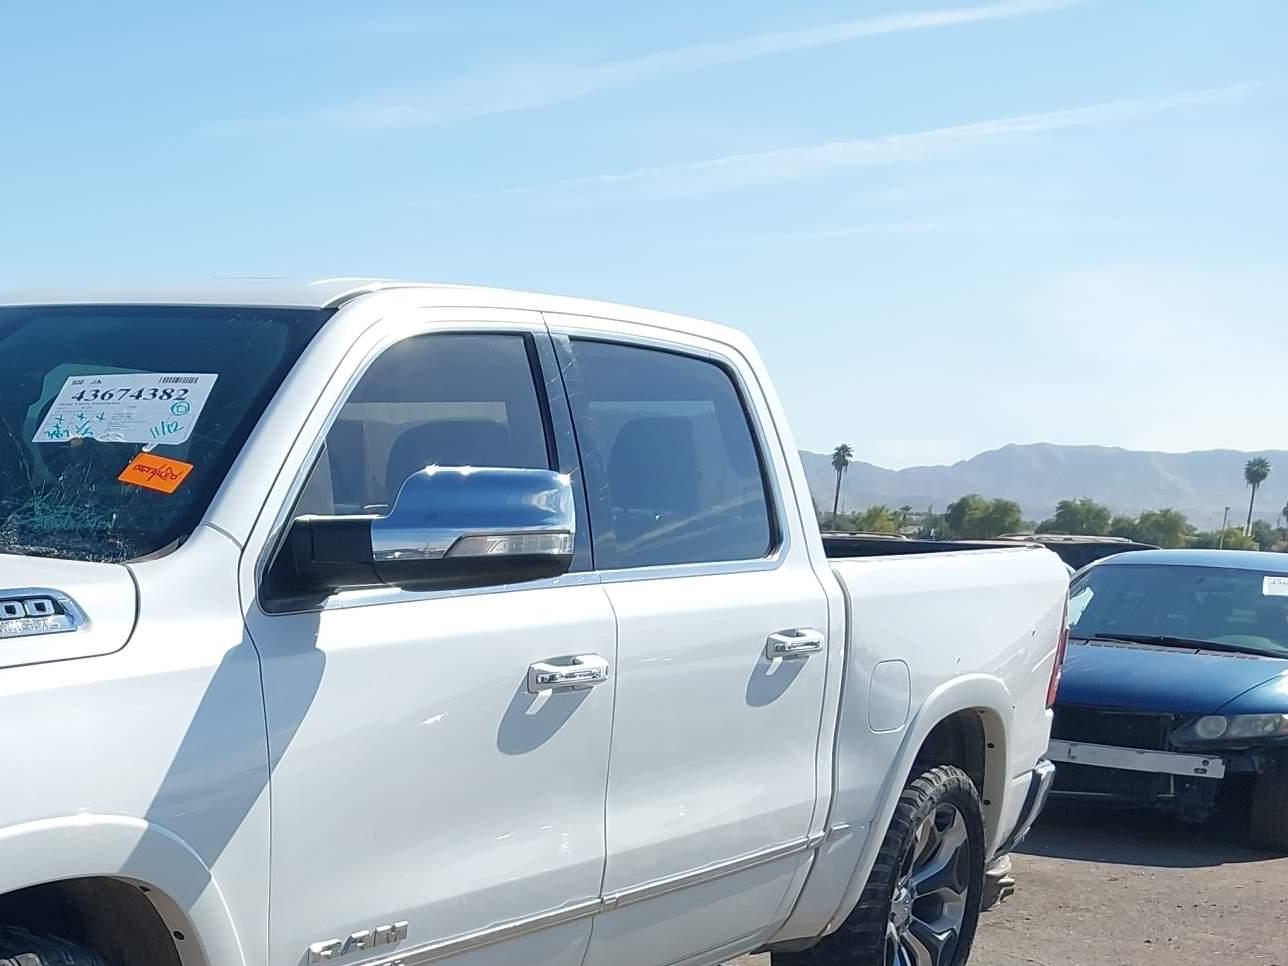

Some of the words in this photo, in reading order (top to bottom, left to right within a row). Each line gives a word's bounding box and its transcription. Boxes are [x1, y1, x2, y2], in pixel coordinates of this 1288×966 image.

[71, 388, 189, 401] 43674382
[150, 421, 184, 439] 11/12
[306, 920, 409, 965] RAM
